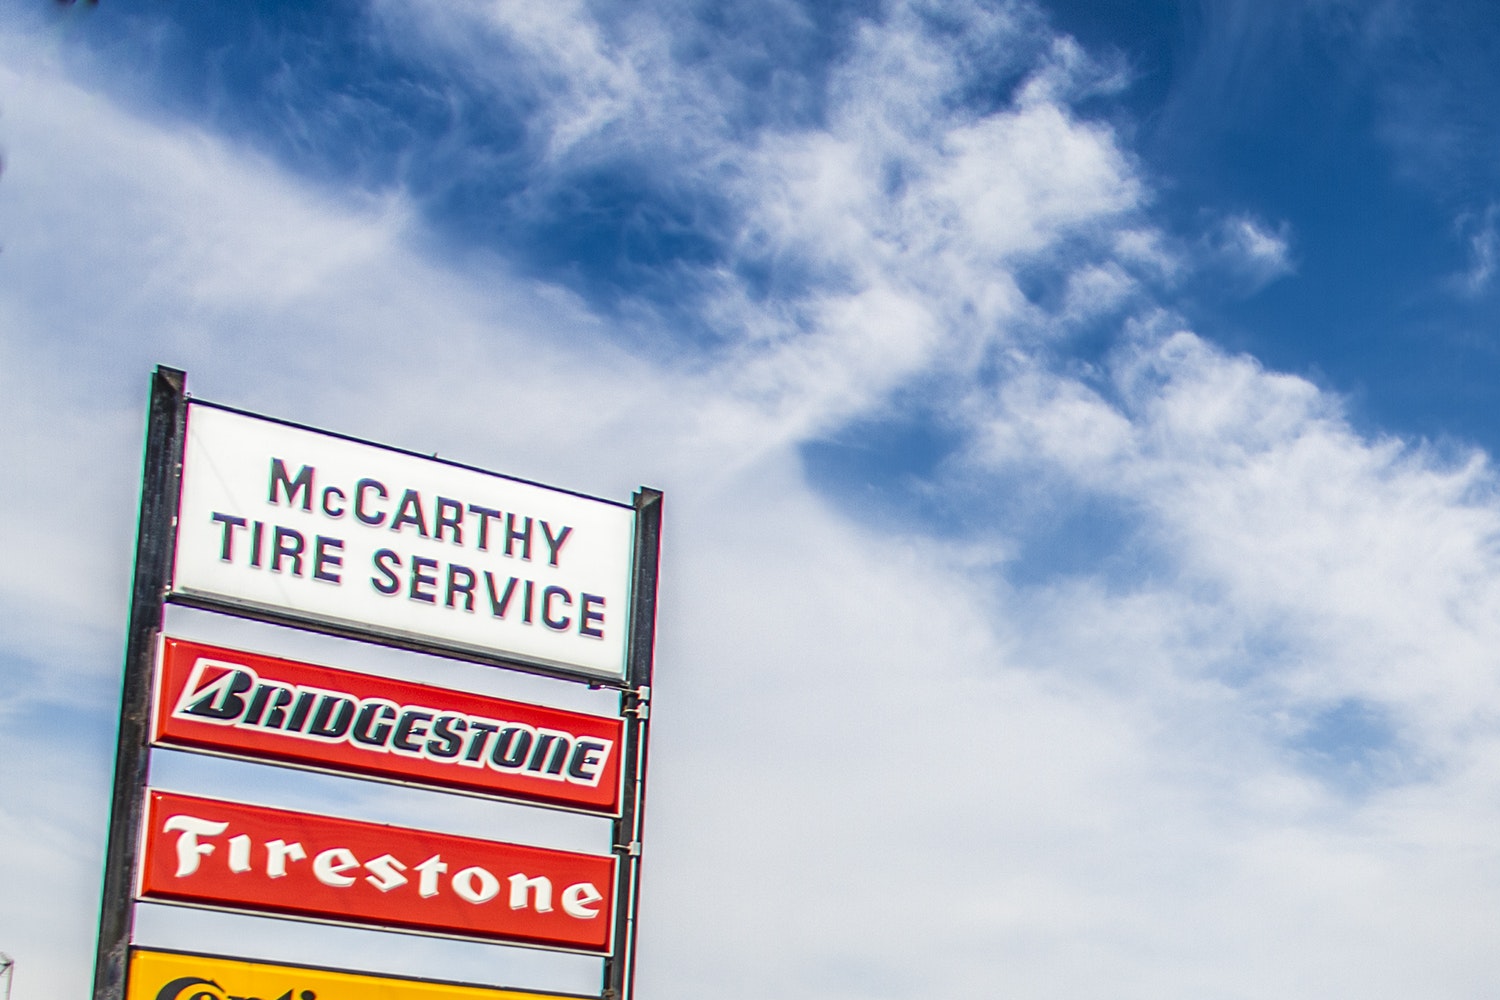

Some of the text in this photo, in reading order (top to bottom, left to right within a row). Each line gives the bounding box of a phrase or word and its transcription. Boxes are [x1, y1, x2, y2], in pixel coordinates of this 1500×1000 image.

[268, 457, 574, 566] McCARTHY
[211, 510, 606, 639] TIRE SERVICE
[181, 653, 610, 781] BRIDGESTONE
[163, 815, 603, 919] Firestone
